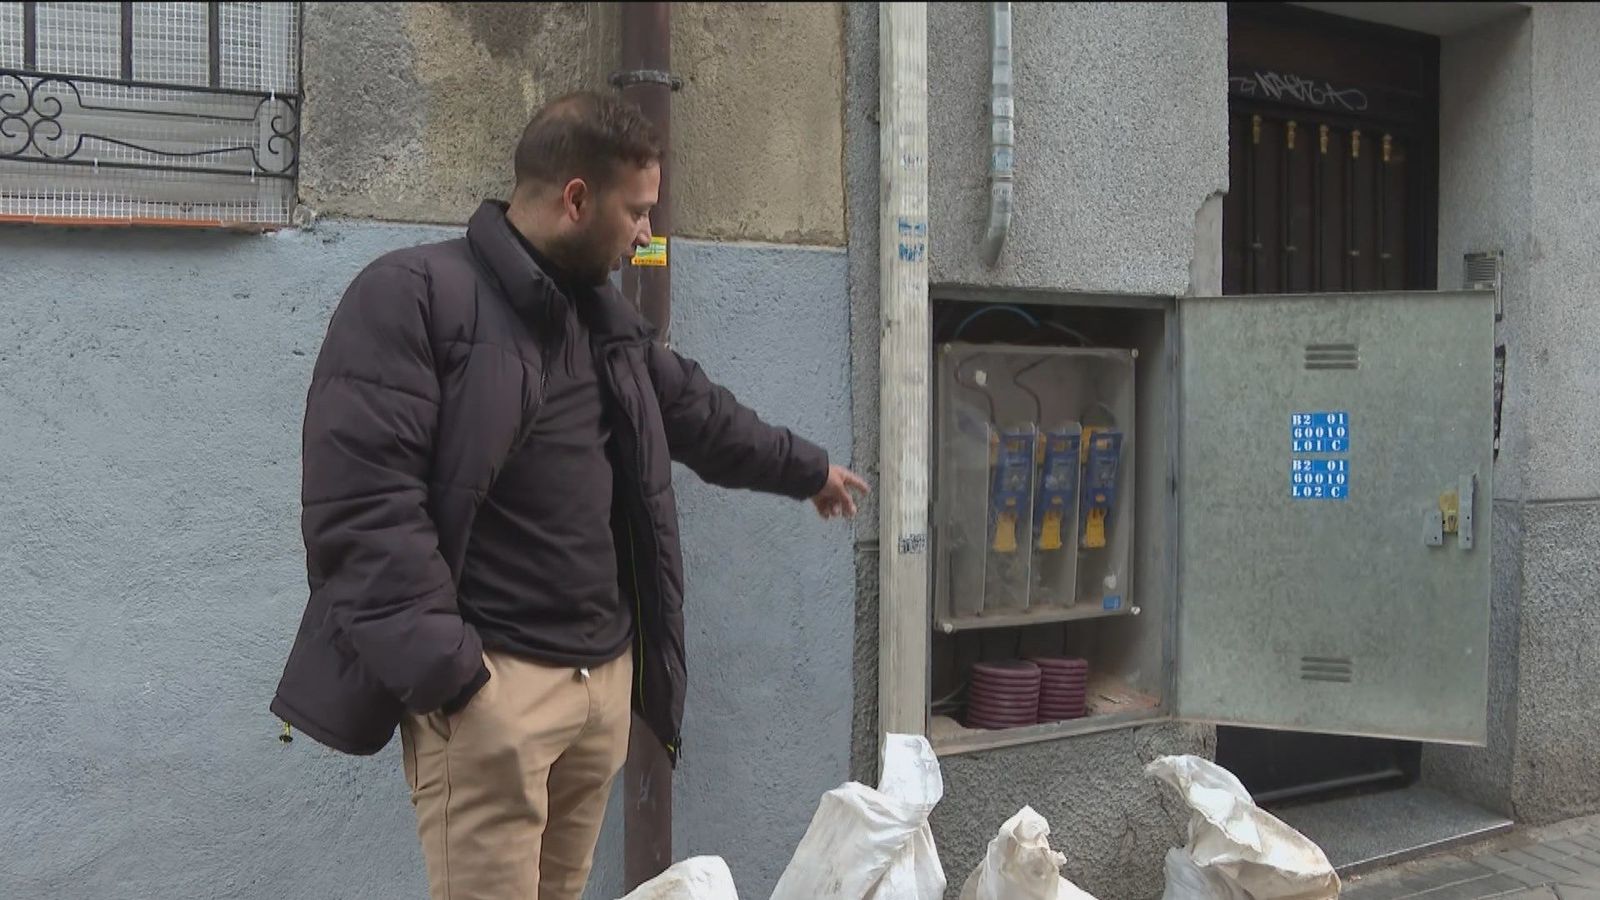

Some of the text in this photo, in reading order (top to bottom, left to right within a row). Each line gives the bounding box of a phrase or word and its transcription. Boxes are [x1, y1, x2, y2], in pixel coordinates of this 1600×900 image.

[1327, 413, 1344, 425] 01
[1294, 427, 1346, 438] 60010
[1293, 439, 1341, 452] L01 C
[1327, 460, 1344, 471] 01
[1294, 473, 1345, 485] 60010
[1292, 486, 1340, 498] L02 C
